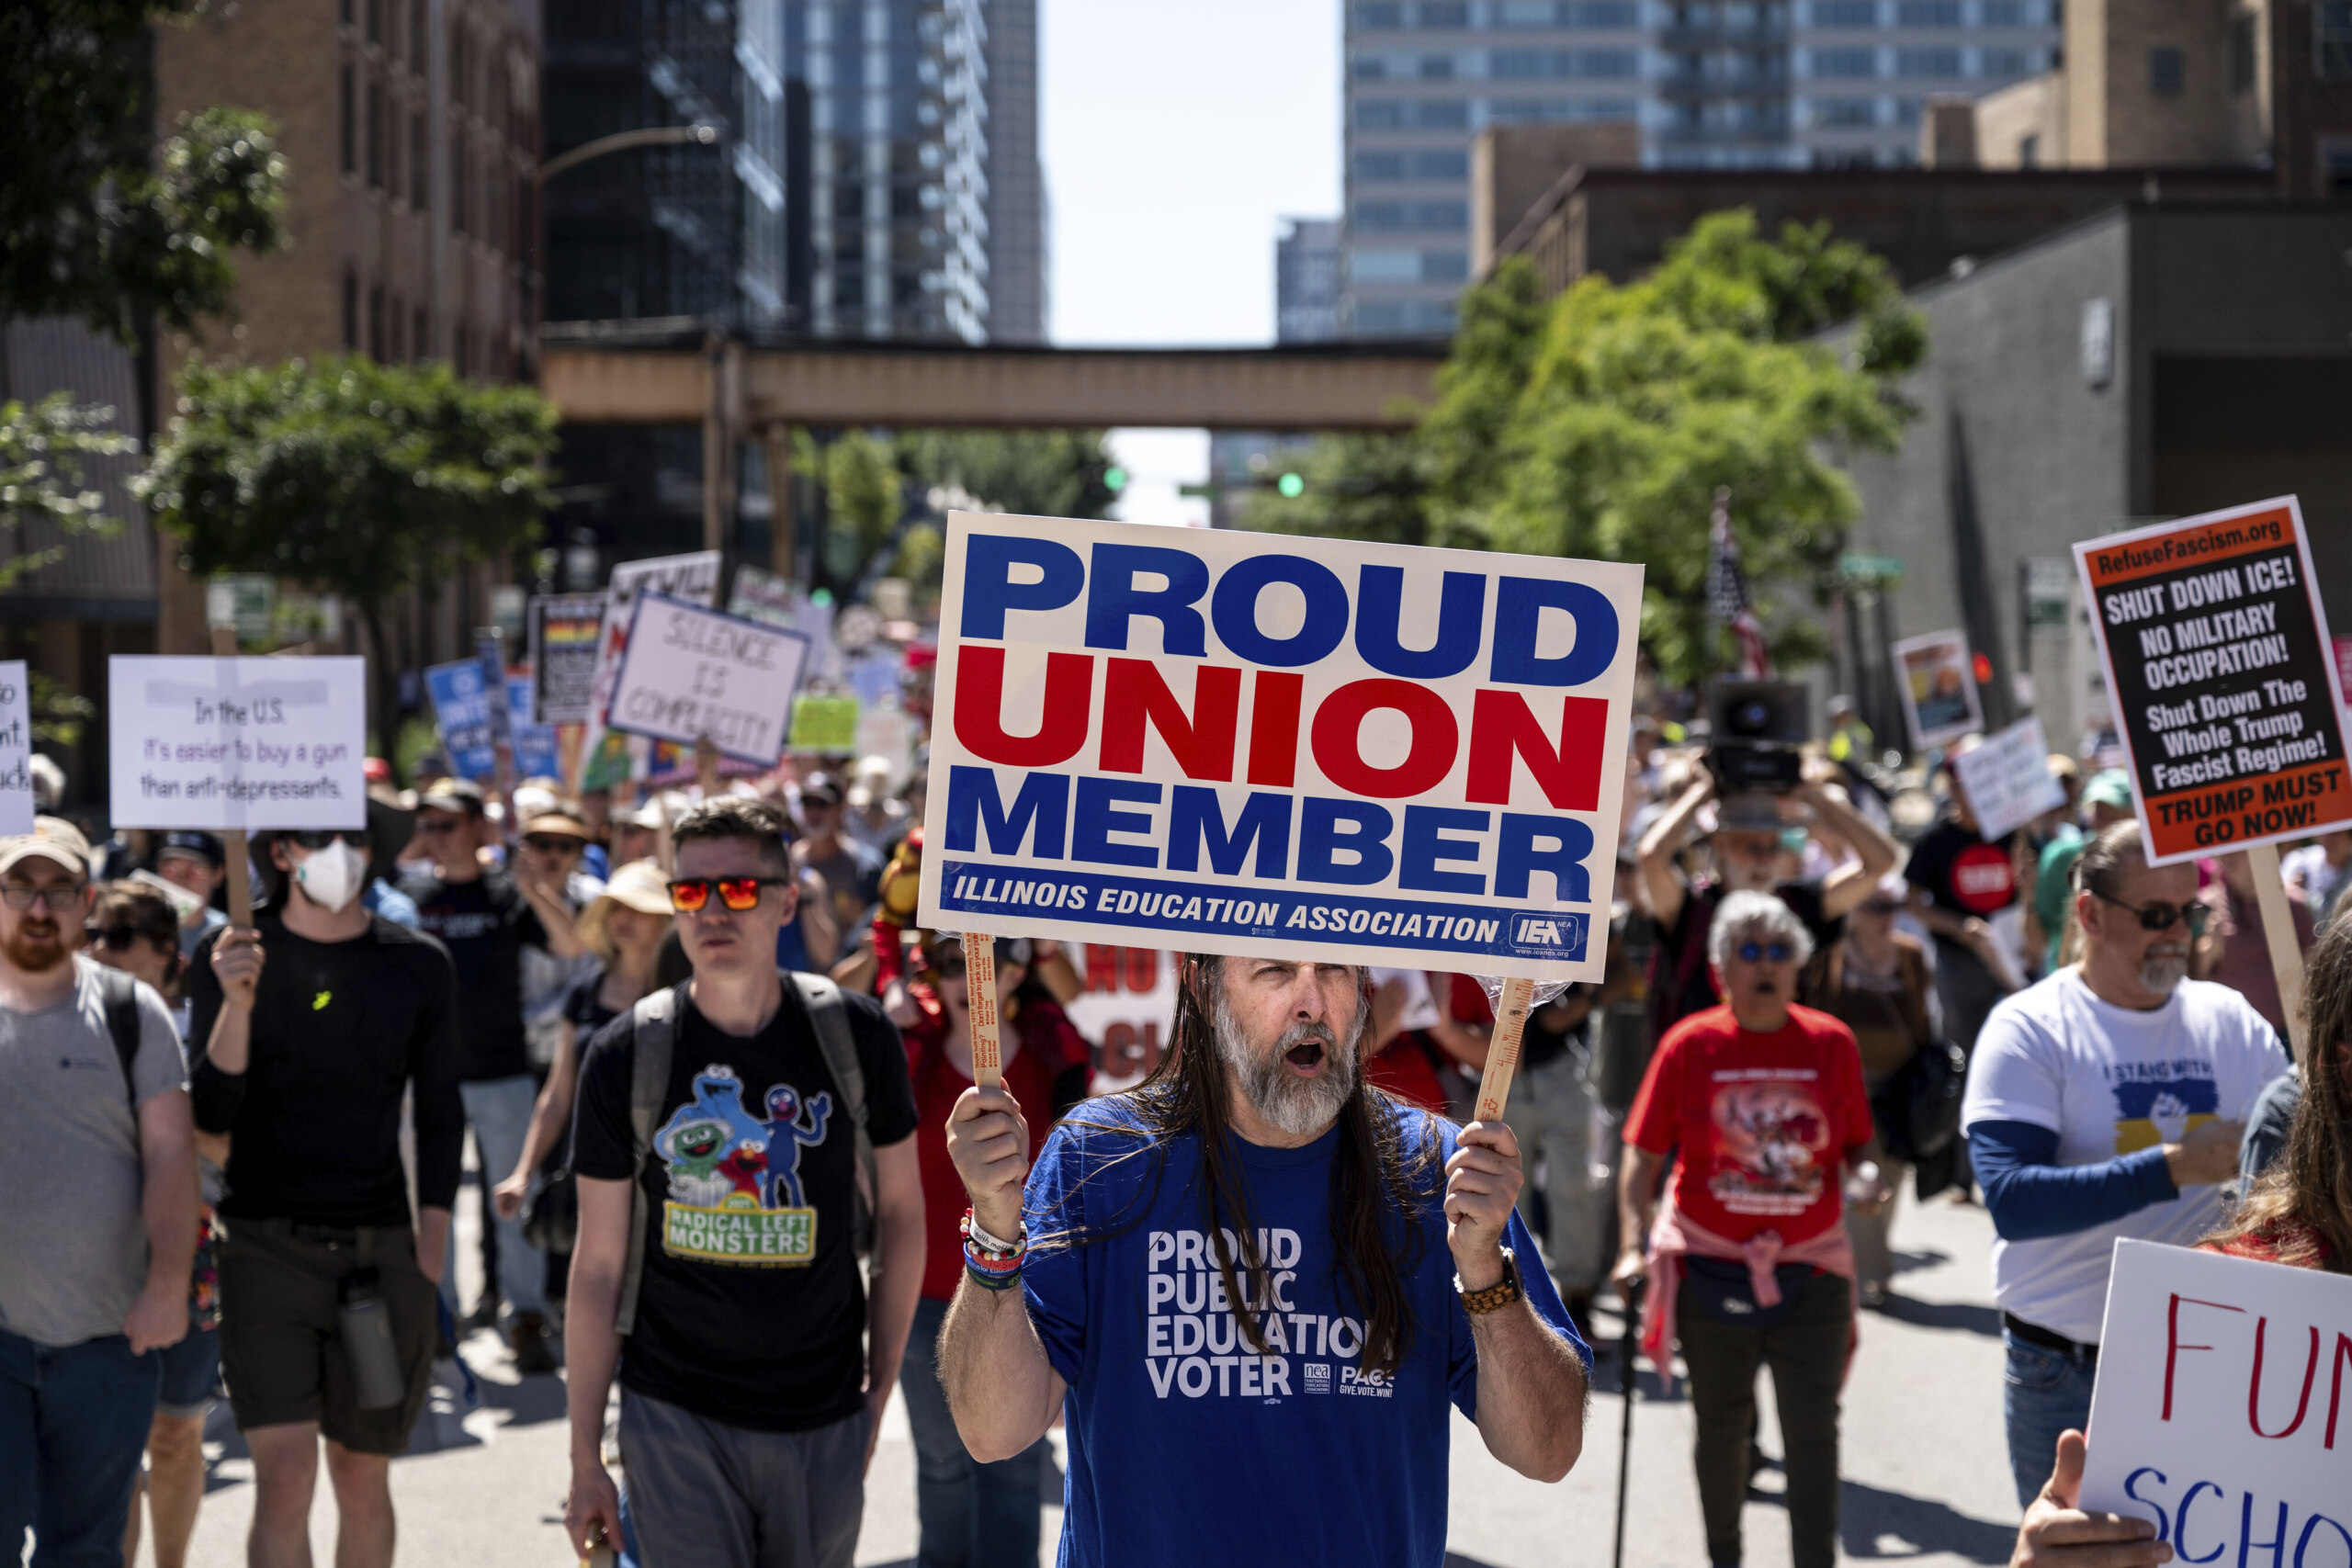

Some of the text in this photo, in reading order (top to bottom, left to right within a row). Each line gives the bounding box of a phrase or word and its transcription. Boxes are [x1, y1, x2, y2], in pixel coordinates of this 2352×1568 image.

[2098, 520, 2280, 575] RefuseFascism.org
[960, 534, 1620, 686] PROUD
[2104, 555, 2295, 625] SHUT DOWN ICE!
[663, 612, 779, 671] SILENCE
[2139, 602, 2276, 660] NO MILITARY
[693, 660, 729, 698] IS
[2144, 634, 2290, 691] OCCUPATION!
[194, 698, 286, 726] In the U.S.
[625, 685, 772, 751] COMPLICITY
[2146, 679, 2307, 732] Shut Down The
[953, 645, 1609, 811] UNION
[2163, 710, 2303, 759] Whole Trump
[175, 739, 228, 762] easier
[235, 738, 252, 762] to
[256, 737, 288, 768] buy
[297, 746, 307, 761] a
[312, 744, 347, 768] gun
[2152, 731, 2328, 790] Fascist Regime!
[141, 773, 344, 803] than anti-depressants.
[2157, 769, 2341, 825] TRUMP MUST
[944, 764, 1594, 903] MEMBER
[2194, 801, 2316, 845] GO NOW!
[953, 875, 1499, 942] ILLINOIS EDUCATION ASSOCIATION
[1516, 919, 1562, 944] IEA
[1516, 949, 1569, 958] www.ieanea.org
[975, 961, 981, 970] up
[975, 971, 983, 984] pick
[977, 992, 985, 1010] forget
[979, 1034, 988, 1068] Painting?
[669, 1225, 808, 1254] MONSTERS
[670, 1209, 808, 1233] RADICAL LEFT
[1148, 1227, 1302, 1271] PROUD
[1148, 1270, 1297, 1314] PUBLIC
[1145, 1356, 1293, 1399] VOTER
[1306, 1365, 1329, 1378] nea
[1340, 1385, 1393, 1398] GIVE.VOTE.WIN!
